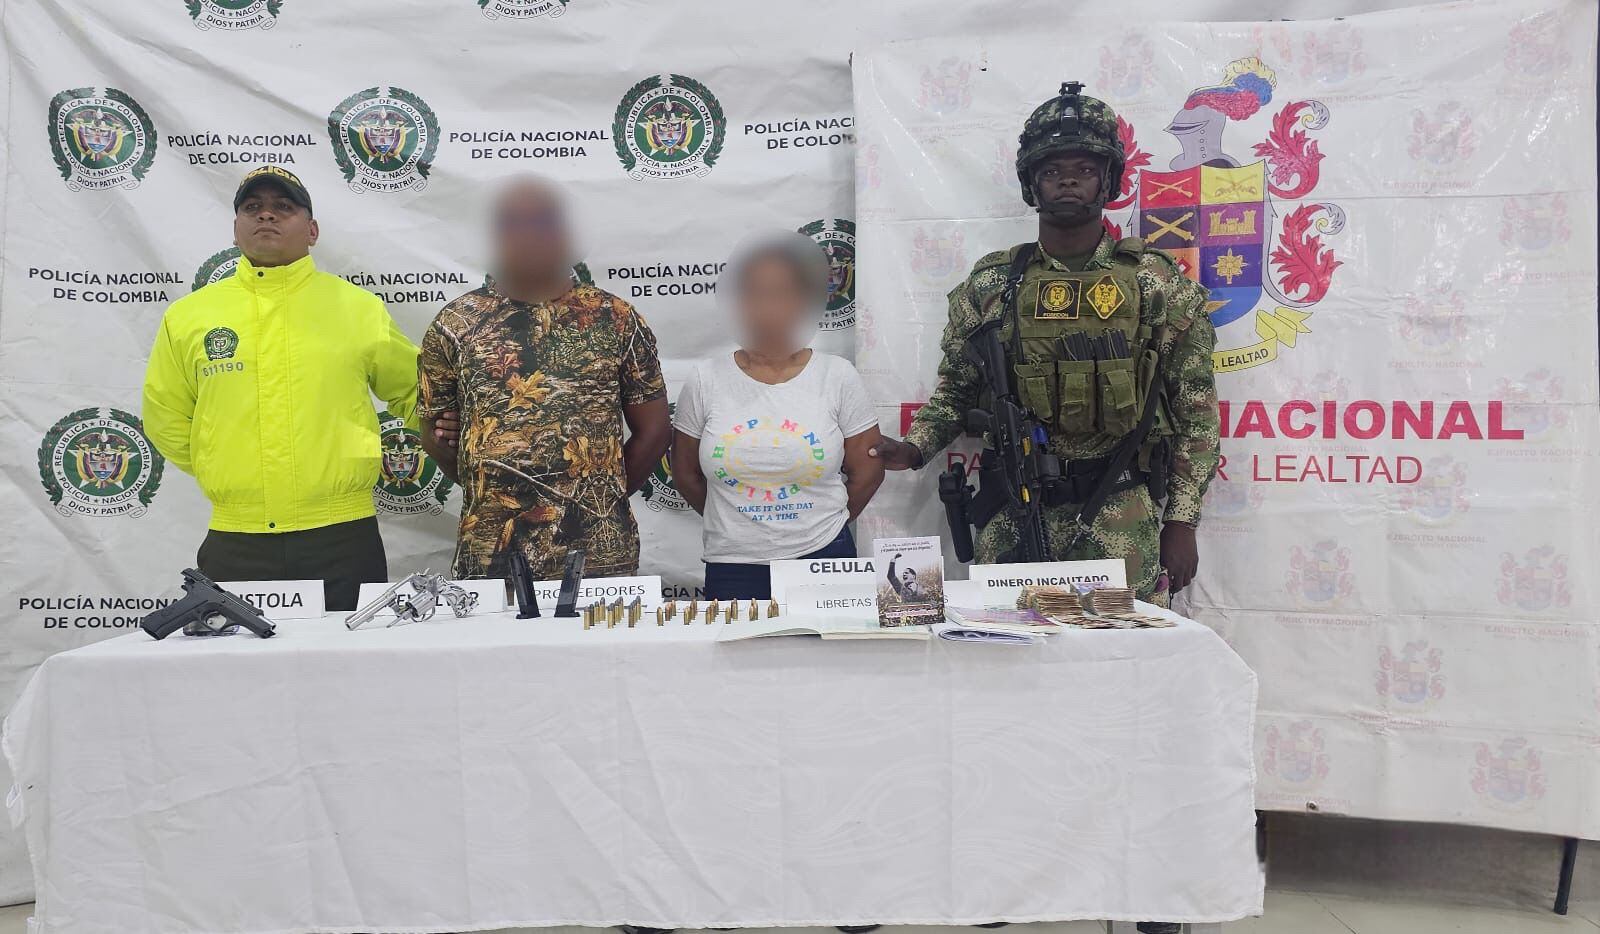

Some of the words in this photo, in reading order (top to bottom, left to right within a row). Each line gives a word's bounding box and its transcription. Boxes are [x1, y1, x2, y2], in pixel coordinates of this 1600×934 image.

[202, 0, 226, 16] LICIA
[524, 2, 553, 16] PATRIA
[236, 14, 264, 28] PATRIA
[684, 92, 712, 136] COLOMBIA
[400, 104, 426, 143] COLOMBIA
[744, 118, 810, 135] POLICÍA
[816, 117, 854, 130] NACI
[168, 131, 222, 147] POLICÍA
[228, 134, 316, 147] NACIONAL
[450, 130, 516, 142] POLICÍA
[521, 130, 608, 142] NACIONAL
[768, 138, 788, 149] DE
[794, 134, 856, 147] COLO
[189, 154, 206, 165] DE
[208, 152, 296, 164] COLOMBIA
[472, 149, 493, 159] DE
[498, 147, 587, 158] COLOMBIA
[670, 144, 709, 168] NACIONAL
[389, 152, 420, 179] NACIONAL
[670, 166, 699, 176] PATRIA
[100, 175, 126, 188] PATRIA
[390, 176, 416, 190] PATRIA
[29, 268, 102, 285] POLICÍA
[106, 272, 184, 285] NACIONAL
[210, 260, 238, 283] UBLICA
[608, 263, 674, 279] POLICÍA
[678, 263, 726, 276] NACI
[345, 272, 376, 286] ICÍA
[380, 273, 468, 285] NACIONAL
[54, 288, 77, 300] DE
[82, 291, 168, 303] COLOMBIA
[374, 291, 446, 303] OLOMBIA
[632, 286, 652, 297] DE
[657, 282, 716, 296] COLOM
[1222, 348, 1269, 368] LEALTAD
[1220, 400, 1524, 440] ACIONAL
[55, 423, 88, 466] REPUBLICA
[122, 426, 150, 470] COLOMBIA
[1253, 454, 1423, 484] LEALTAD
[59, 476, 90, 502] POLICIA
[102, 479, 146, 504] NACIONAL
[373, 485, 395, 502] LICIA
[102, 503, 134, 514] PATRIA
[406, 502, 432, 512] PATRIA
[988, 578, 1032, 588] DINERO
[240, 592, 303, 608] STOLA
[535, 585, 646, 600] PROEEDORES
[19, 595, 95, 610] POLICÍA
[100, 598, 179, 610] NACION
[816, 598, 872, 609] LIBRETAS
[44, 617, 68, 629] DE
[74, 617, 144, 628] COLOM
